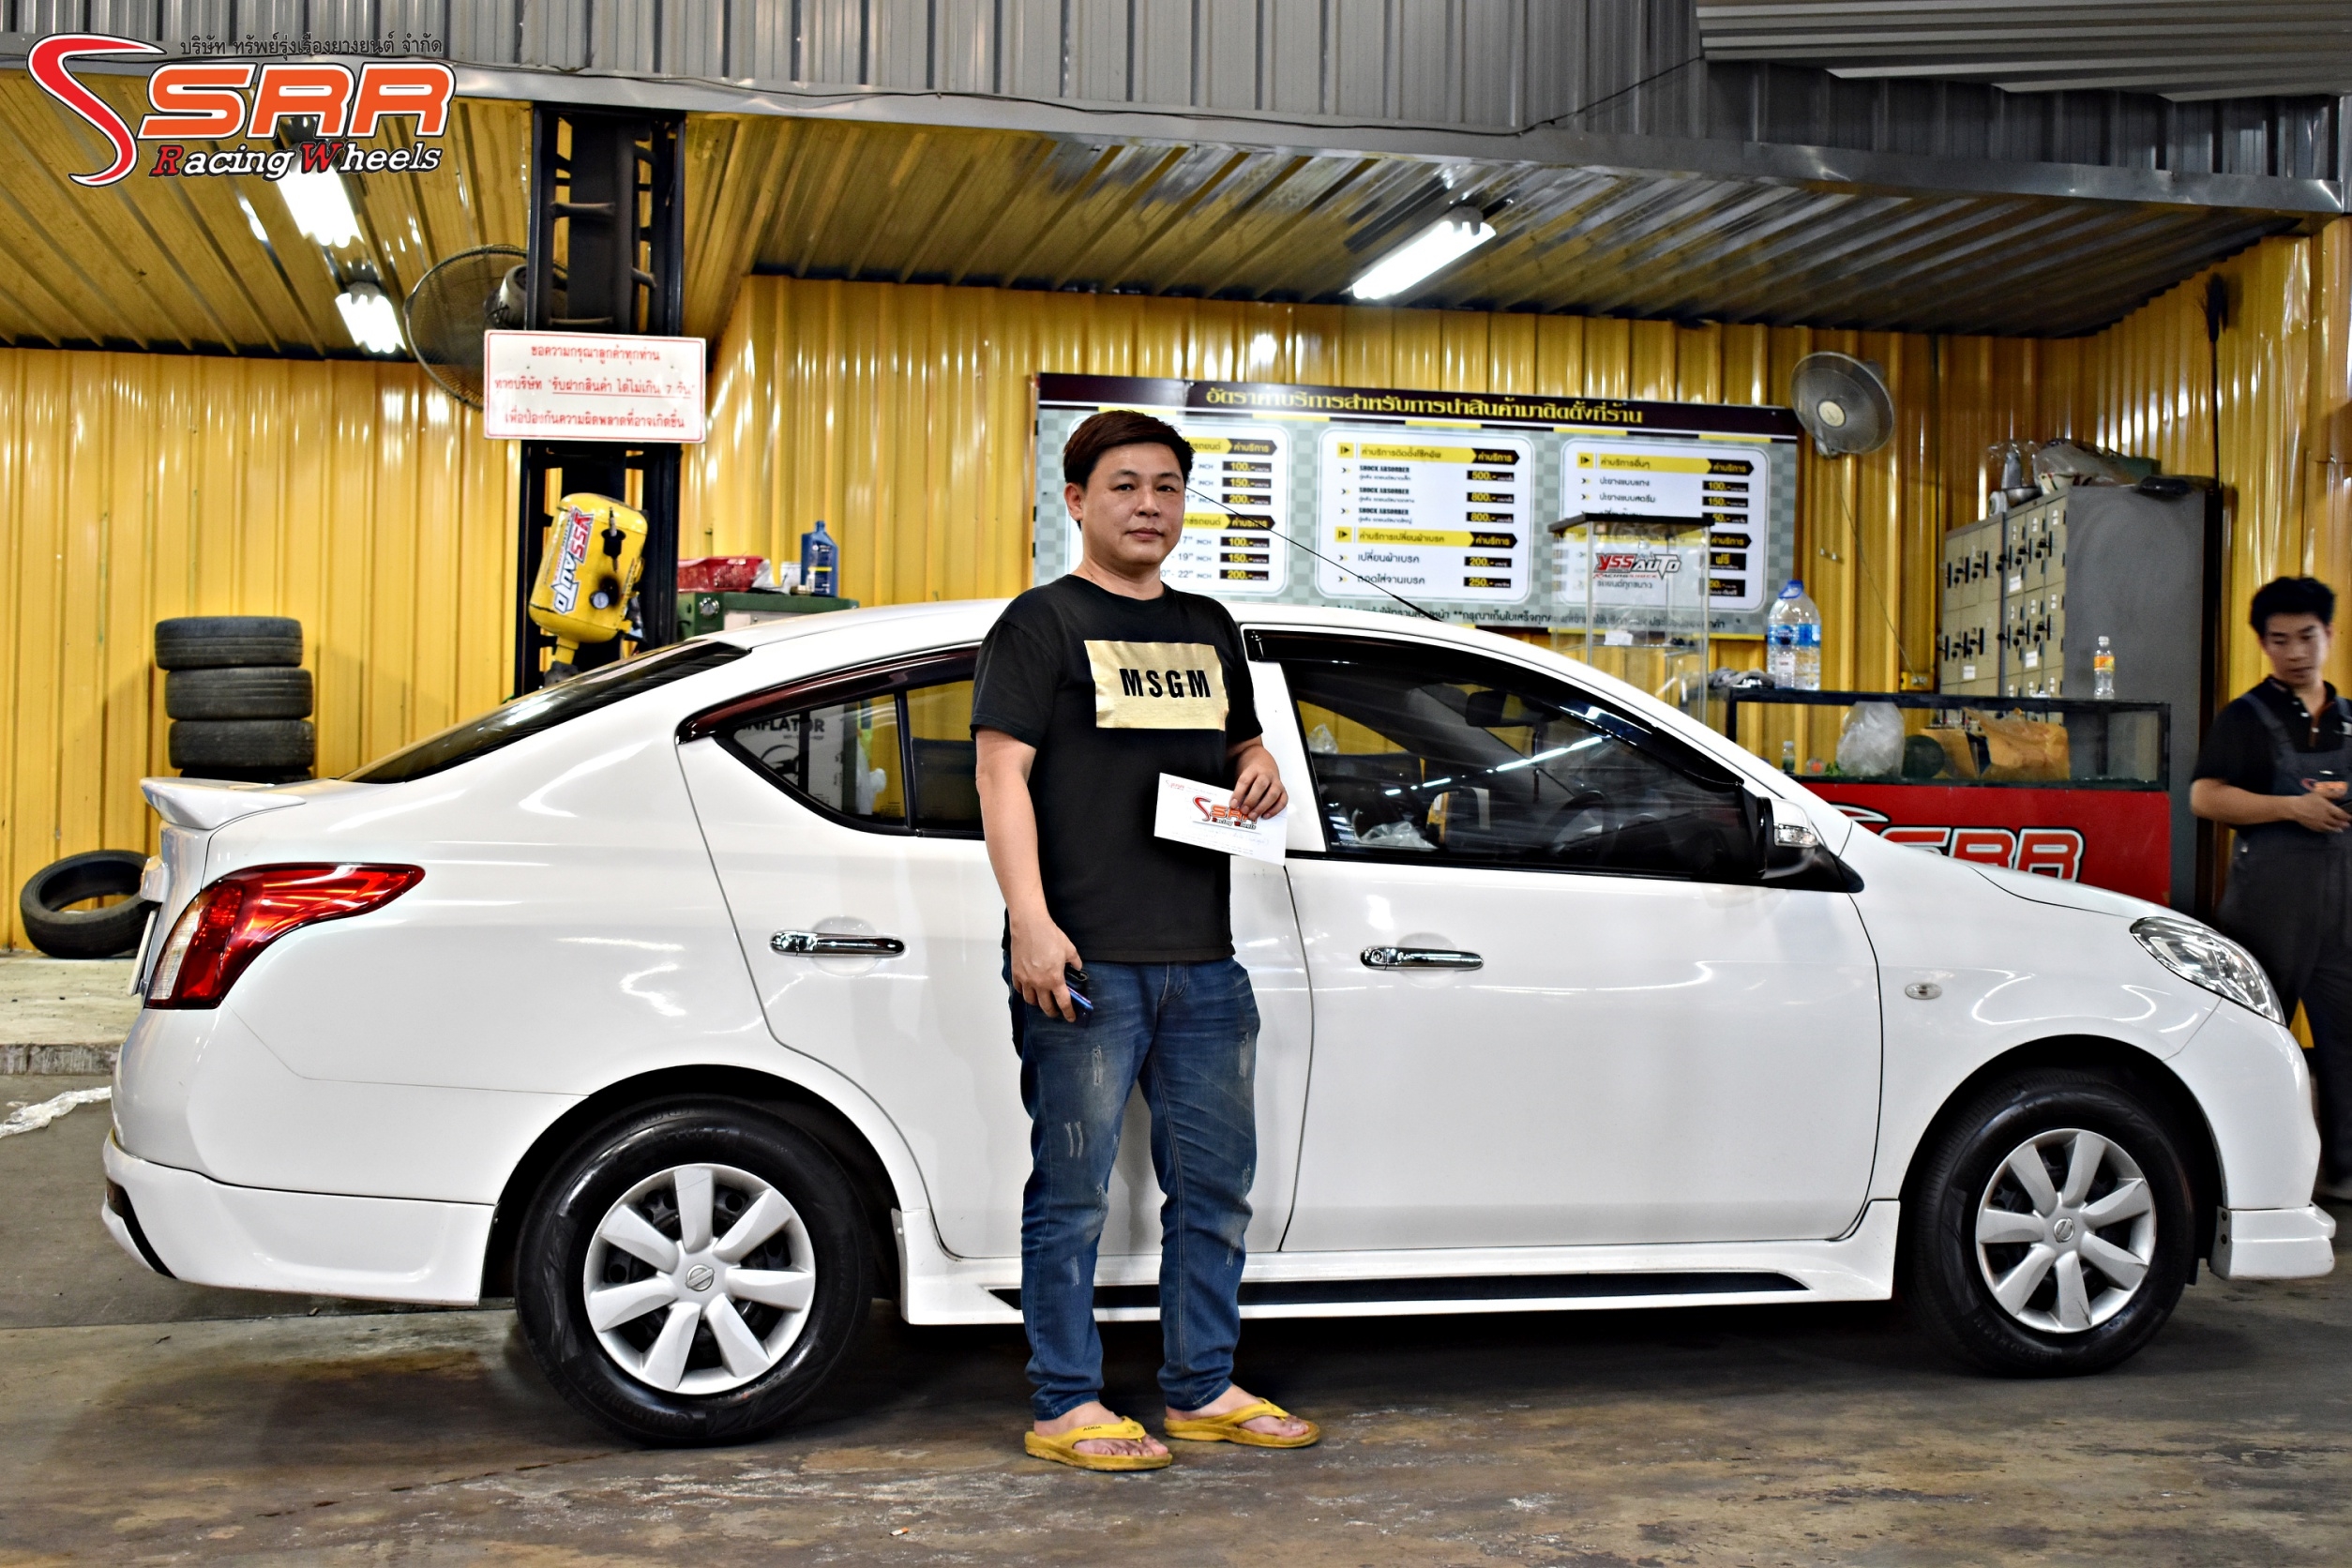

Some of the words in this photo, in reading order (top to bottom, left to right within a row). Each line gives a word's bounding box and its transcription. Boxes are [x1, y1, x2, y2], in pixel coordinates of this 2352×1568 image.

[666, 385, 672, 394] 7
[570, 512, 592, 560] YSS
[1596, 553, 1636, 571] YSS
[1119, 668, 1212, 699] MSGM
